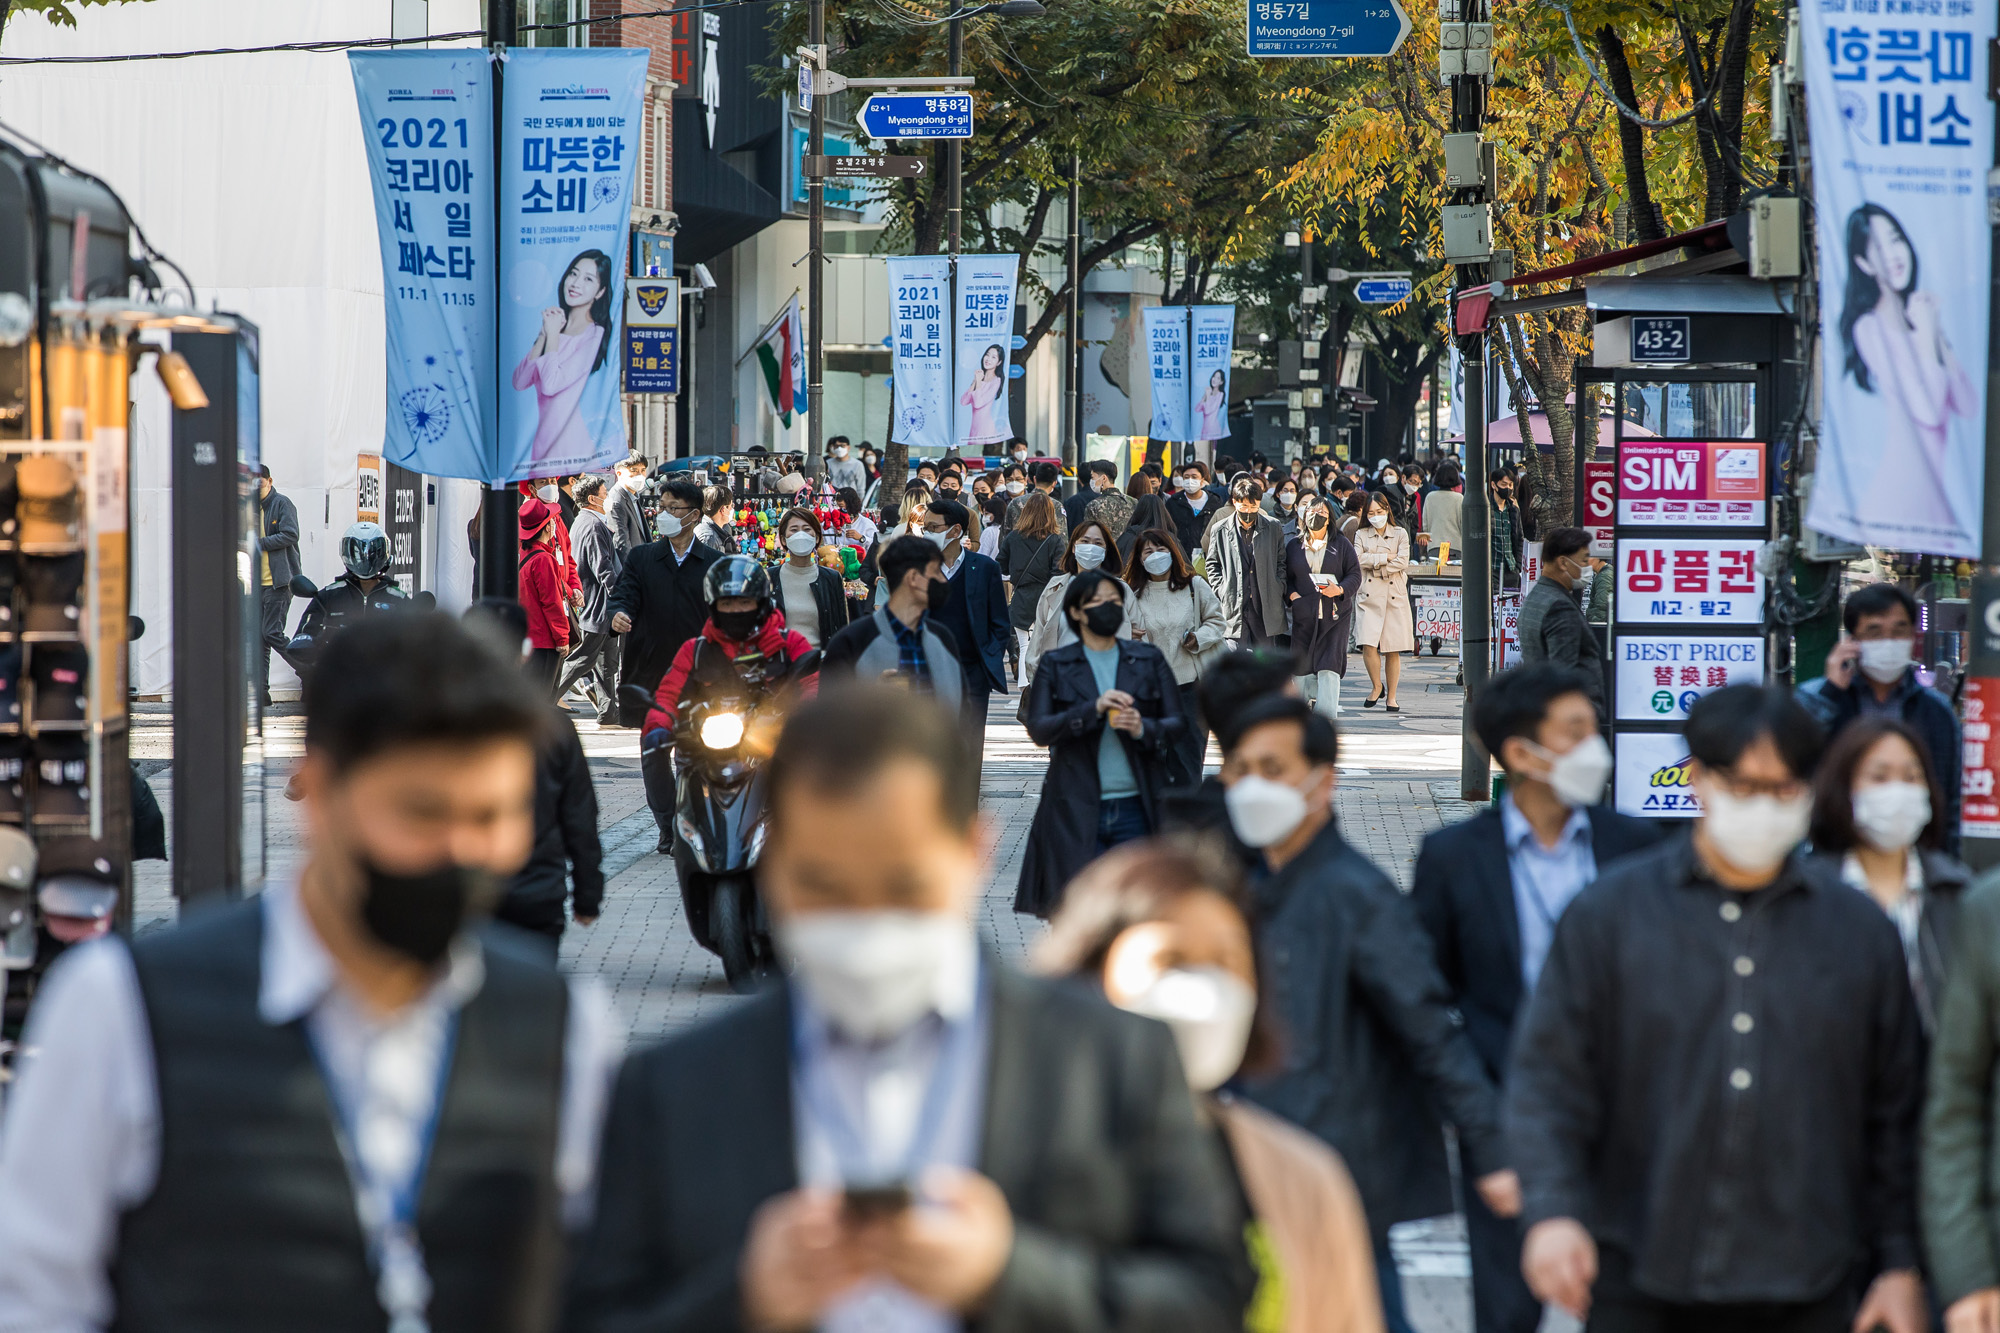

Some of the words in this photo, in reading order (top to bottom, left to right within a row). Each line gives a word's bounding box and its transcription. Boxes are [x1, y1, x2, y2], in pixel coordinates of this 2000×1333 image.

[1256, 2, 1310, 20] 명동7길
[1378, 9, 1390, 18] 26
[1256, 26, 1326, 38] Myeongdong
[1329, 25, 1355, 38] 7-gil
[870, 104, 880, 112] 62
[925, 98, 969, 113] 명동8길
[523, 117, 543, 128] 국민
[545, 117, 583, 128] 모두에게
[586, 116, 605, 128] 힘이
[888, 115, 946, 125] Myeongdong
[947, 115, 969, 125] 8-gil
[377, 118, 468, 148] 2021
[523, 135, 625, 173] 따뜻한
[386, 157, 474, 194] 코리아
[521, 177, 587, 213] 소비
[398, 240, 476, 281] 페스타
[399, 286, 427, 301] 11.1
[442, 292, 476, 306] 11.15
[898, 287, 939, 301] 2021
[965, 294, 1009, 311] 따뜻한
[898, 305, 941, 320] 코리아
[965, 313, 993, 328] 소비
[631, 331, 673, 339] 남대문경찰서
[1152, 329, 1180, 338] 2021
[1197, 333, 1229, 346] 따뜻한
[1637, 331, 1684, 348] 43-2
[899, 343, 942, 359] 페스타
[1153, 341, 1181, 352] 코리아
[1197, 347, 1219, 358] 소비
[632, 357, 672, 370] 파출소
[1679, 452, 1698, 461] LTE
[1623, 457, 1697, 491] SIM
[395, 489, 414, 522] EIDER
[394, 533, 413, 565] SEOUL
[1626, 549, 1756, 593] 상품권
[1651, 600, 1683, 615] 사고
[1700, 600, 1732, 615] 팔고
[1625, 643, 1683, 661] BEST
[1689, 643, 1756, 662] PRICE
[1654, 666, 1728, 688] 替換錢
